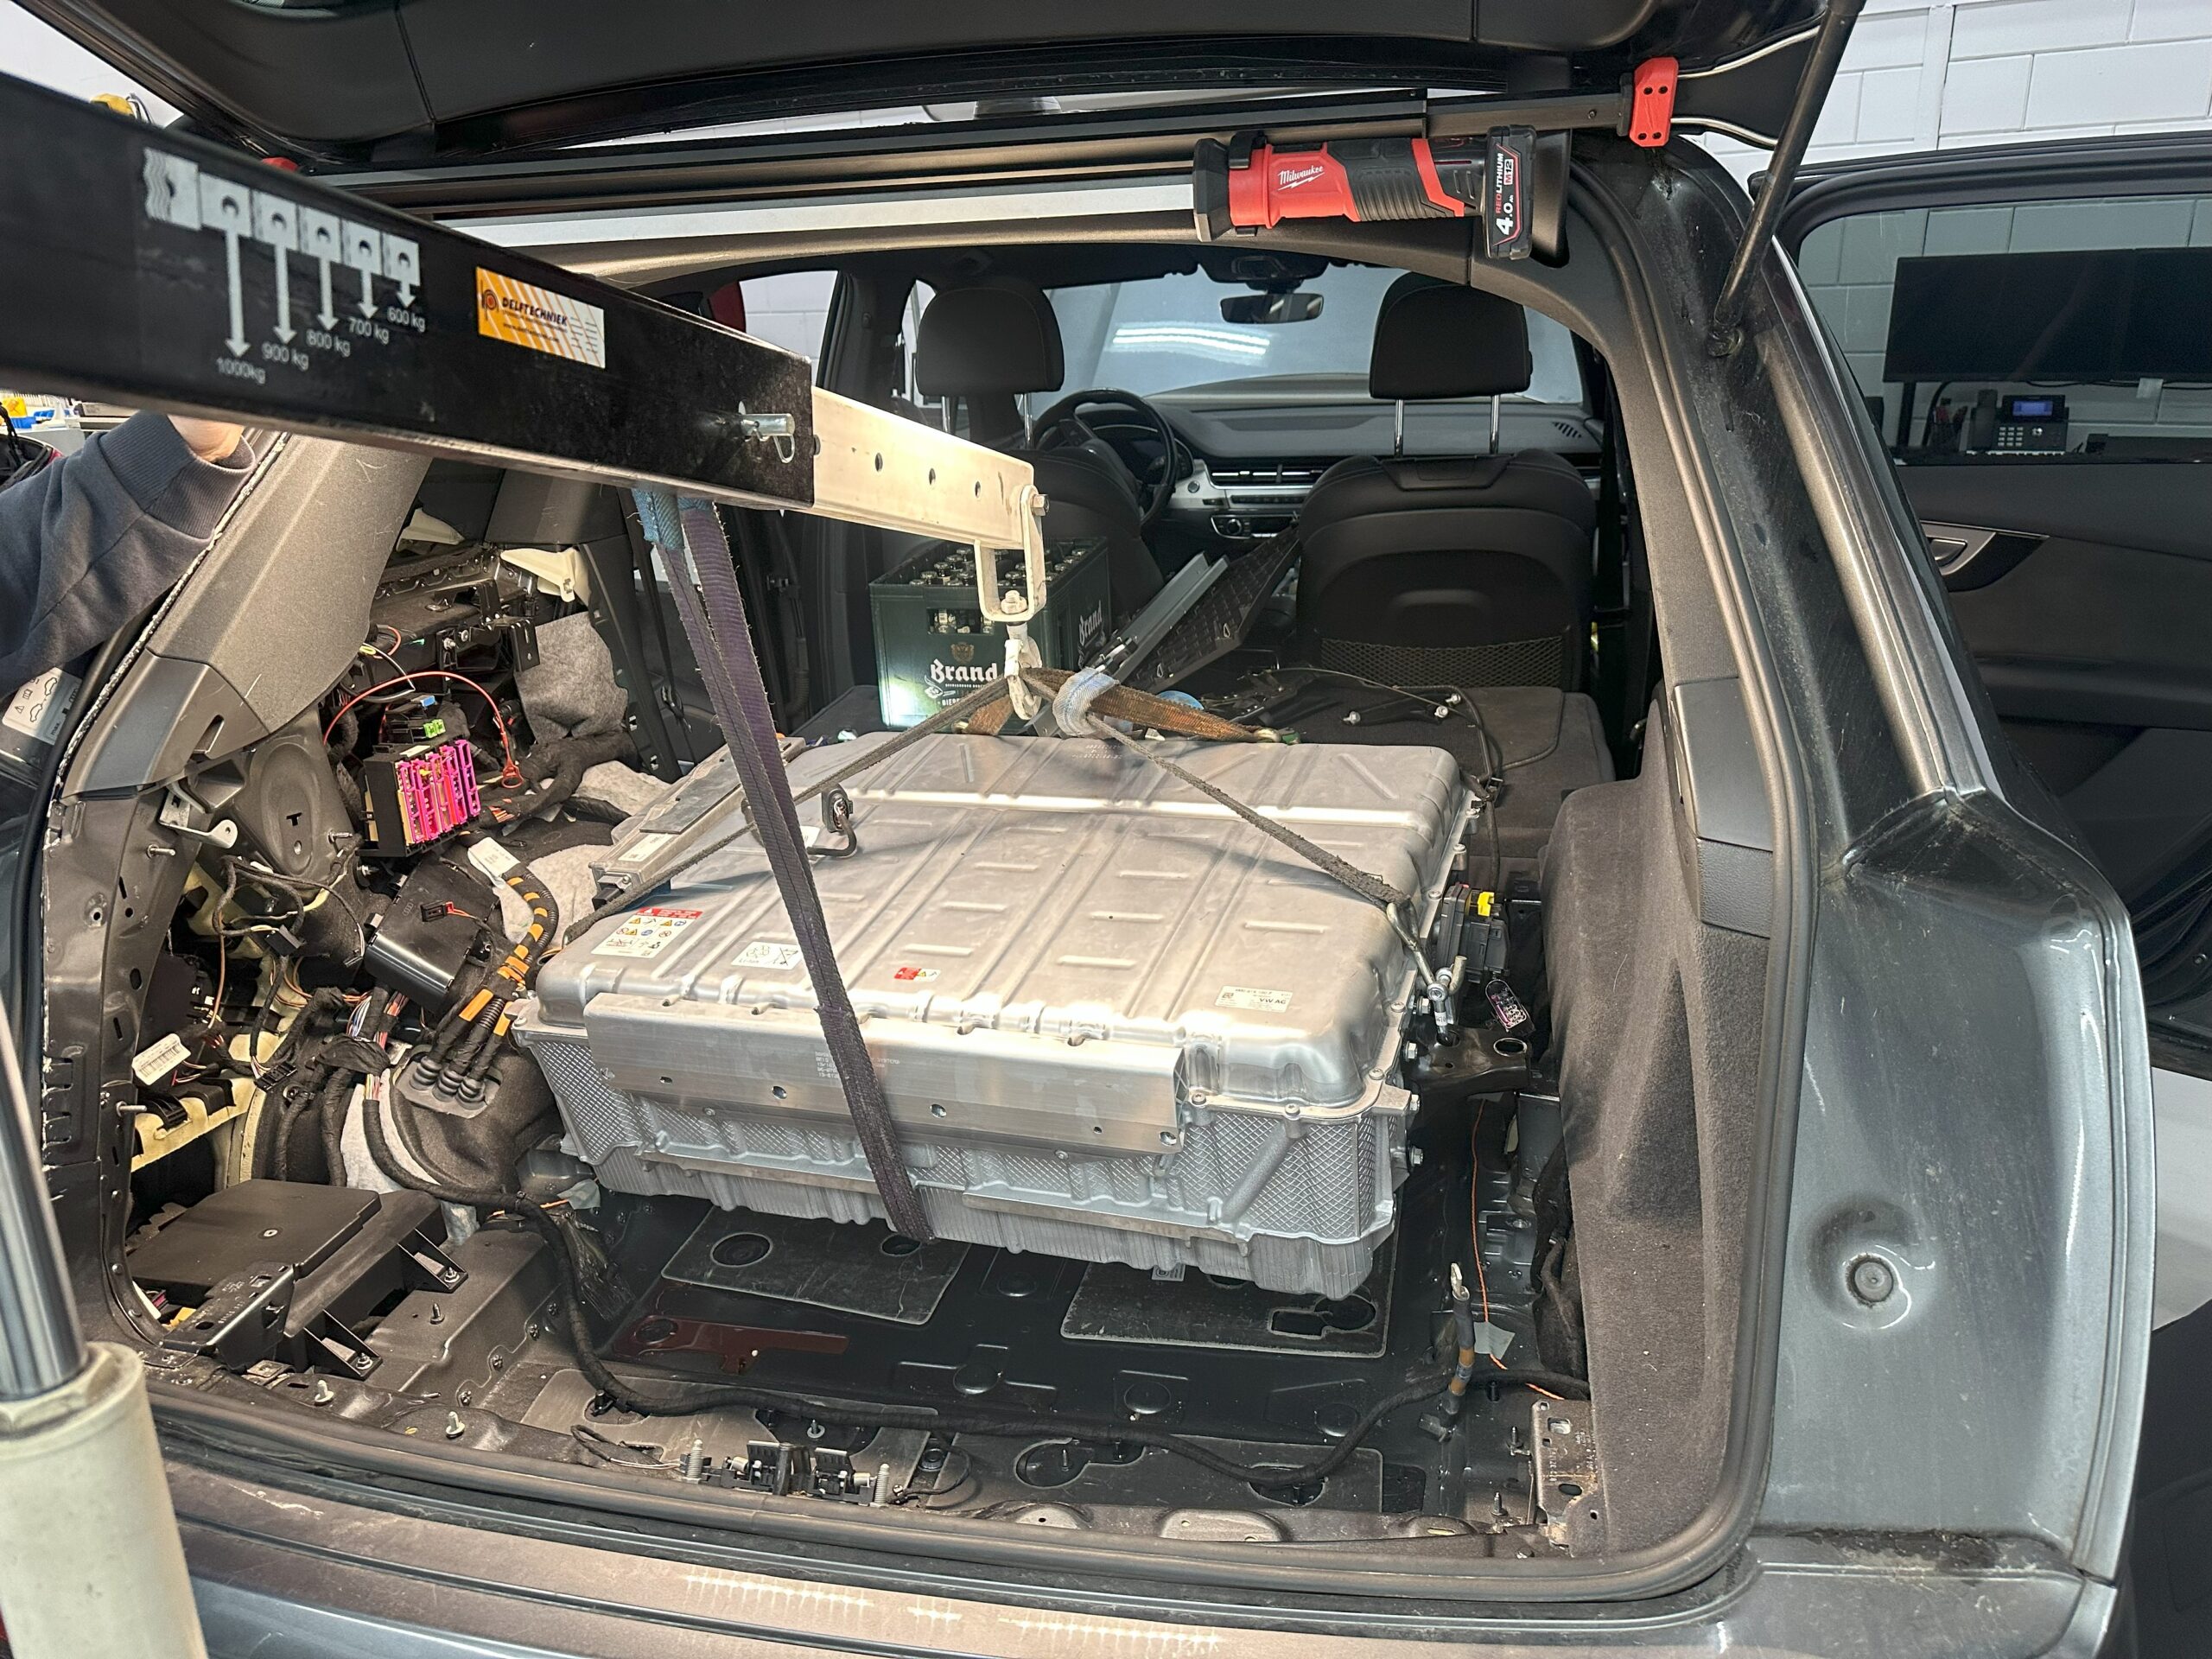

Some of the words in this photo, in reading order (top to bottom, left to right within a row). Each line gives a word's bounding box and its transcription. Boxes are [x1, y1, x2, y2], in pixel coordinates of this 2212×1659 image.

[1277, 164, 1324, 185] Milwaukee
[1495, 152, 1504, 214] REDLITHIUM
[1504, 161, 1513, 186] M12
[1496, 202, 1514, 236] 4.0
[387, 306, 410, 325] 600
[410, 313, 426, 333] kg
[502, 297, 568, 327] DELFTECHNIEK
[306, 328, 332, 350] 800
[334, 335, 351, 358] kg
[348, 316, 372, 337] 700
[374, 325, 390, 346] kg
[216, 357, 266, 385] 1000kg
[262, 342, 289, 362] 900
[291, 349, 309, 371] kg
[1078, 599, 1103, 646] Brand
[930, 658, 998, 683] Brand
